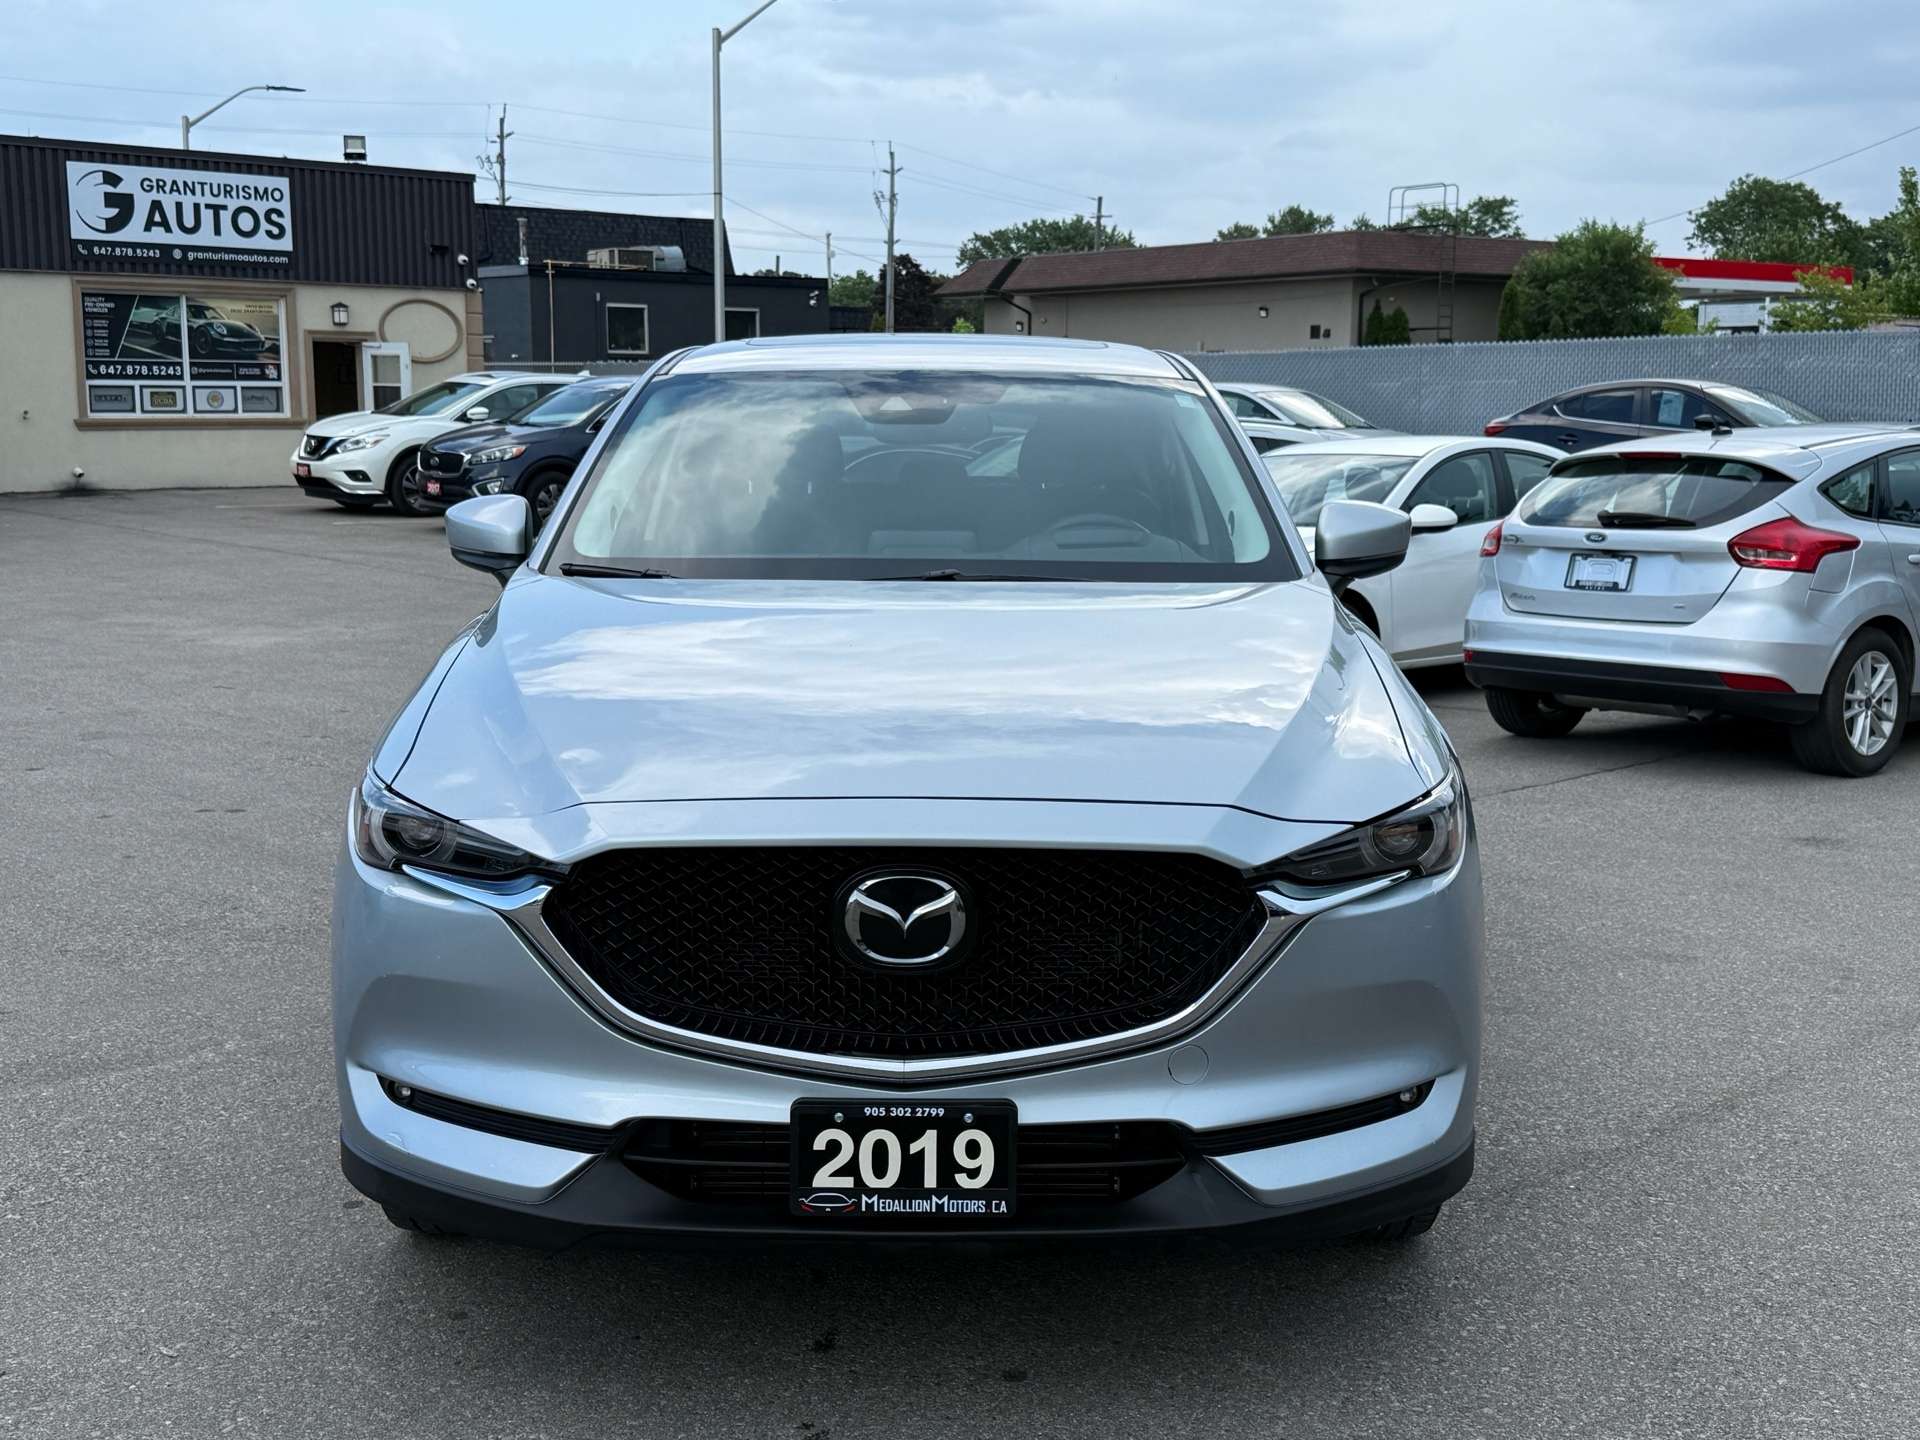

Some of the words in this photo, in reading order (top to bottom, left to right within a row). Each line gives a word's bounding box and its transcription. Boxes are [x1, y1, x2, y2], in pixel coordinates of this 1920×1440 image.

[140, 177, 284, 203] GRANTURISMO
[143, 199, 287, 240] AUTOS
[93, 246, 160, 258] 647.878.5243
[187, 250, 289, 264] granturismoautos.com
[100, 364, 182, 376] 647.878.5243
[864, 1107, 886, 1117] 905
[889, 1107, 912, 1117] 302
[915, 1107, 945, 1117] 2799
[811, 1128, 995, 1189] 2019
